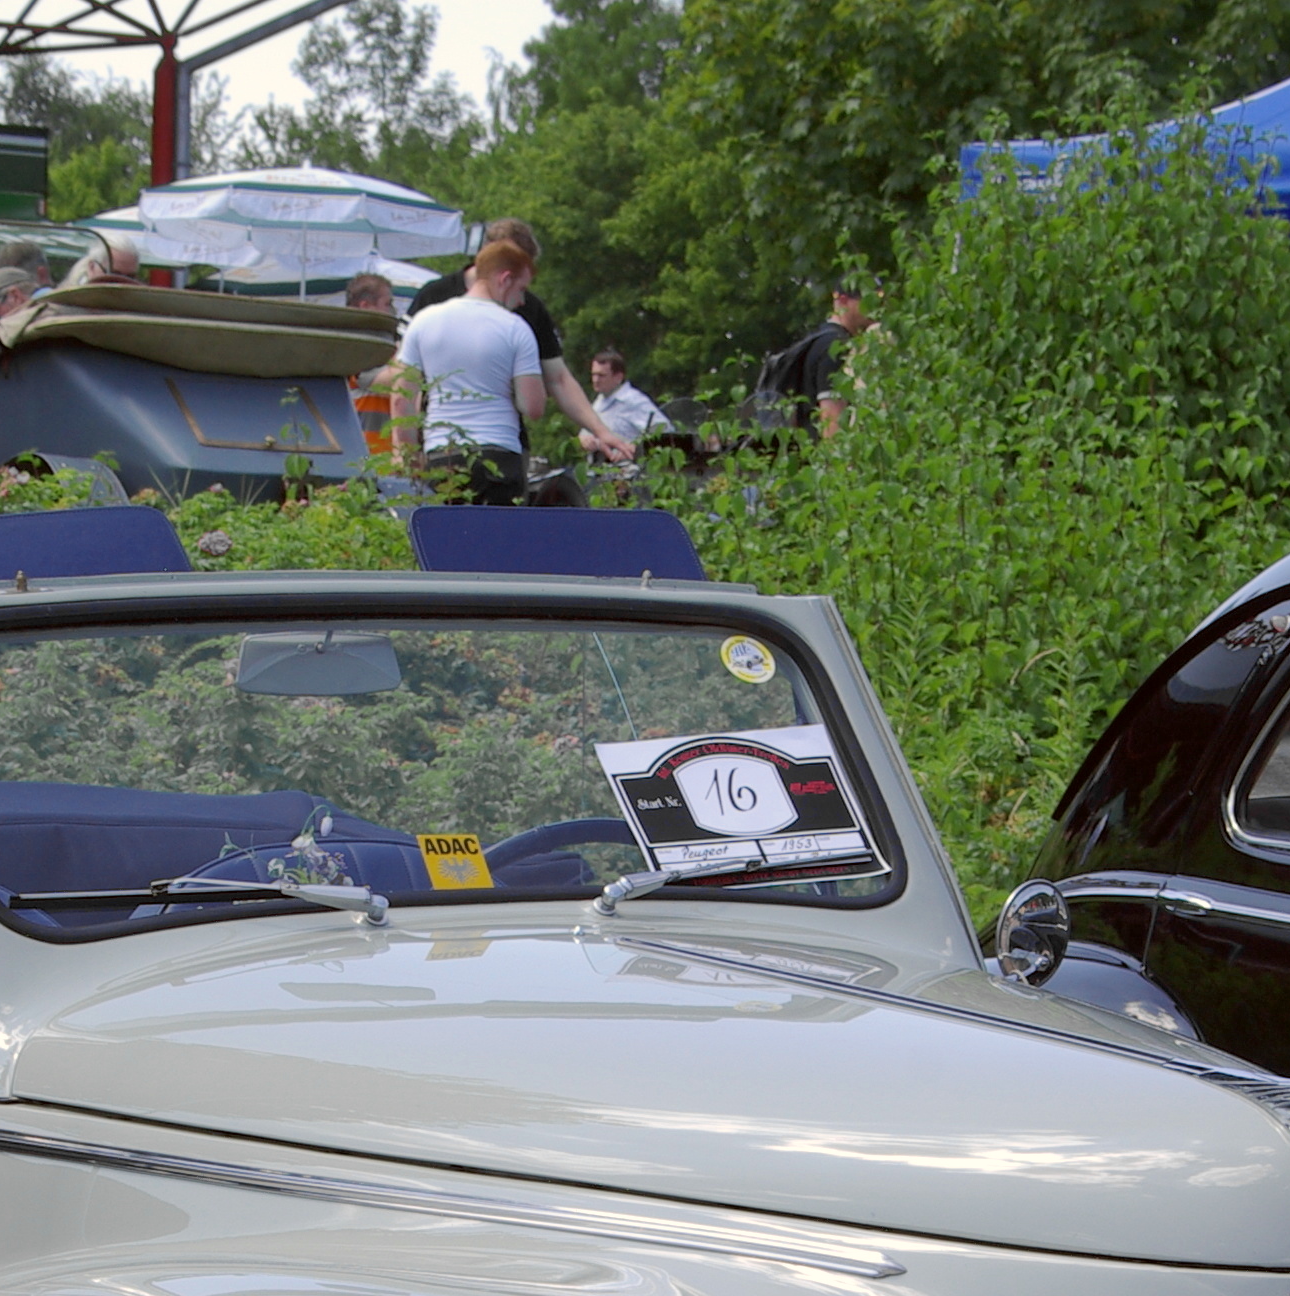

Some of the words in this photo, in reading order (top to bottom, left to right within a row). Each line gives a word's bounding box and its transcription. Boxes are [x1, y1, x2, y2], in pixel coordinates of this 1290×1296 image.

[705, 767, 758, 817] 16
[637, 798, 664, 811] Start
[665, 795, 683, 808] Nr.
[424, 837, 479, 856] ADAC
[782, 837, 813, 851] 1953
